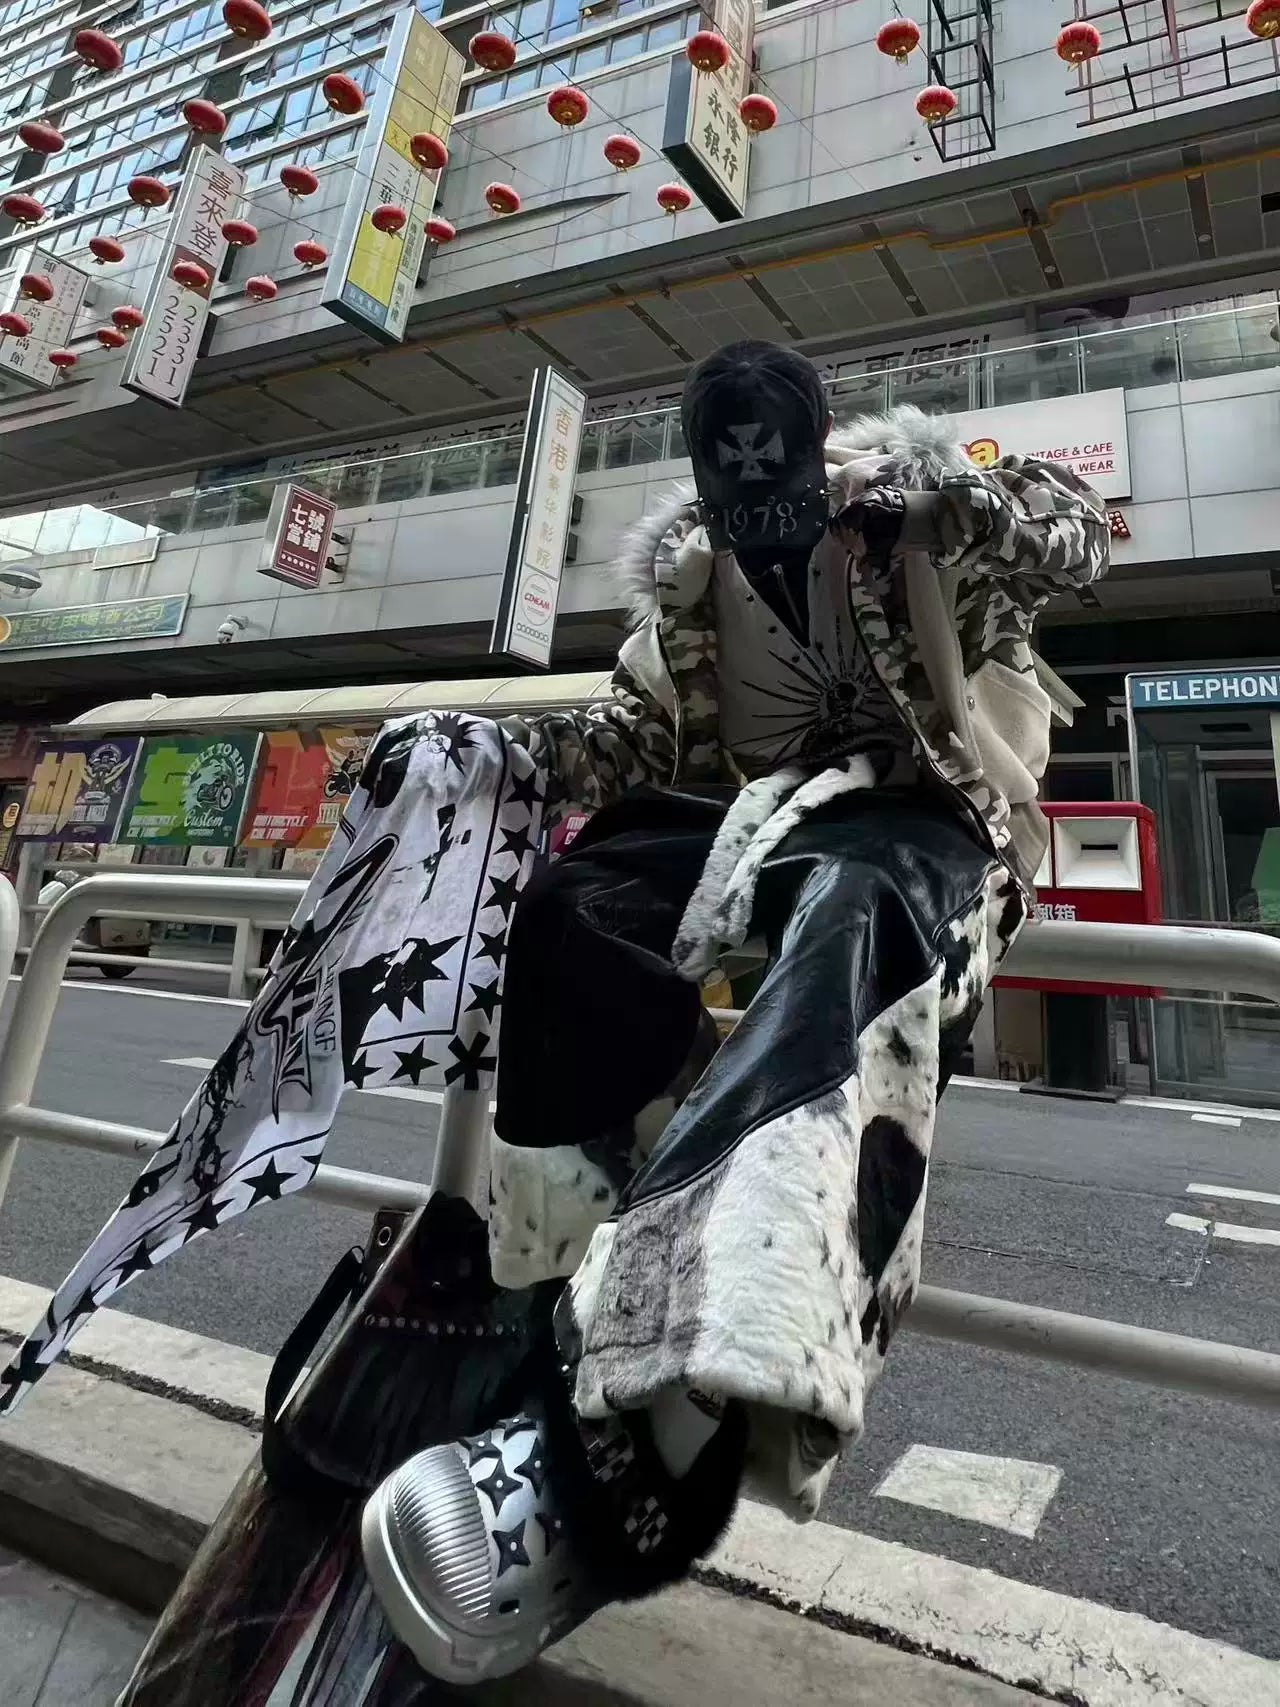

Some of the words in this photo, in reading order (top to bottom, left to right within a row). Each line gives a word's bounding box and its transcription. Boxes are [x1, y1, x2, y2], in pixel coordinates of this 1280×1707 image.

[1071, 446, 1081, 456] &
[1083, 441, 1113, 455] CAFE
[1078, 459, 1114, 474] WEAR
[1139, 674, 1280, 702] TELEPHON
[183, 808, 224, 828] Custom
